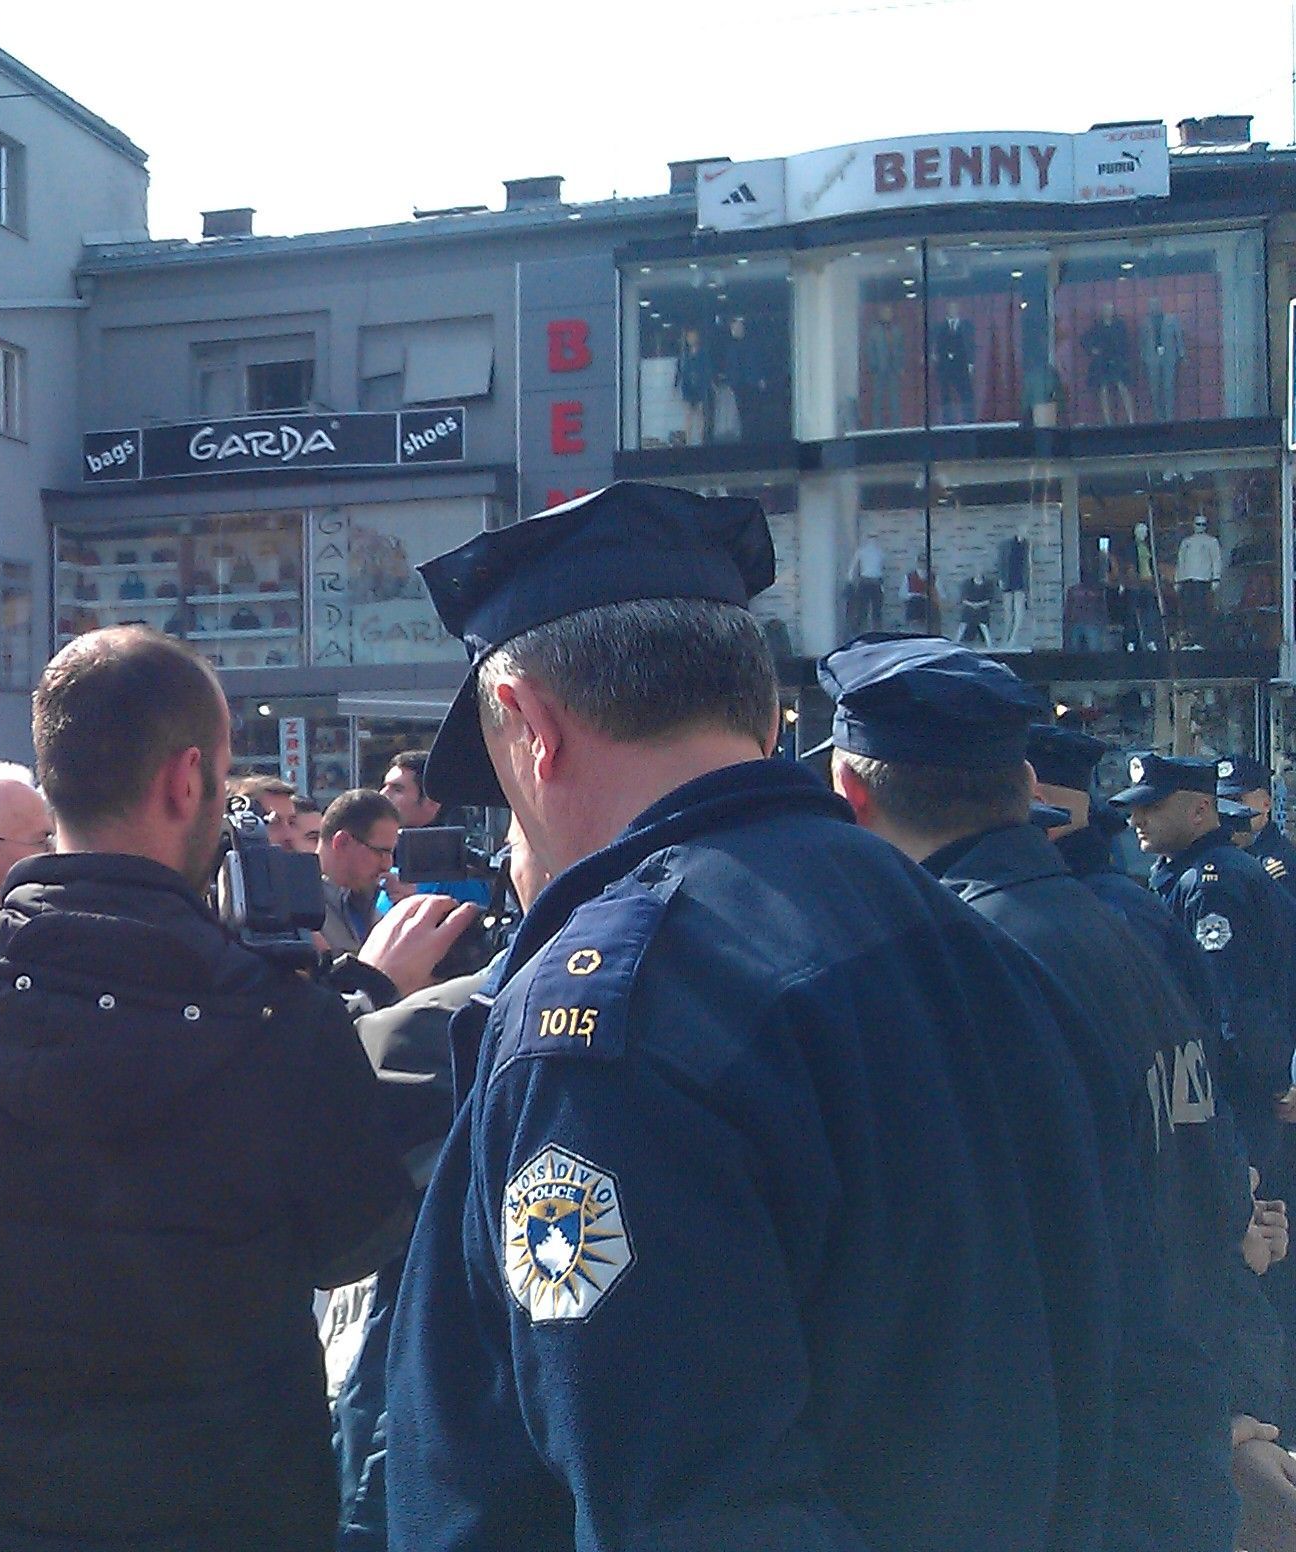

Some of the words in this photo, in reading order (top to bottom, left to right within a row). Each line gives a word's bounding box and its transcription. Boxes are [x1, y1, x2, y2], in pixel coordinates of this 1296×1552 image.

[873, 146, 1056, 194] BENNY
[86, 437, 136, 473] bags
[188, 425, 336, 461] GARDA
[402, 414, 459, 456] shoes
[539, 1006, 598, 1039] 1015
[527, 1184, 577, 1204] POLICE
